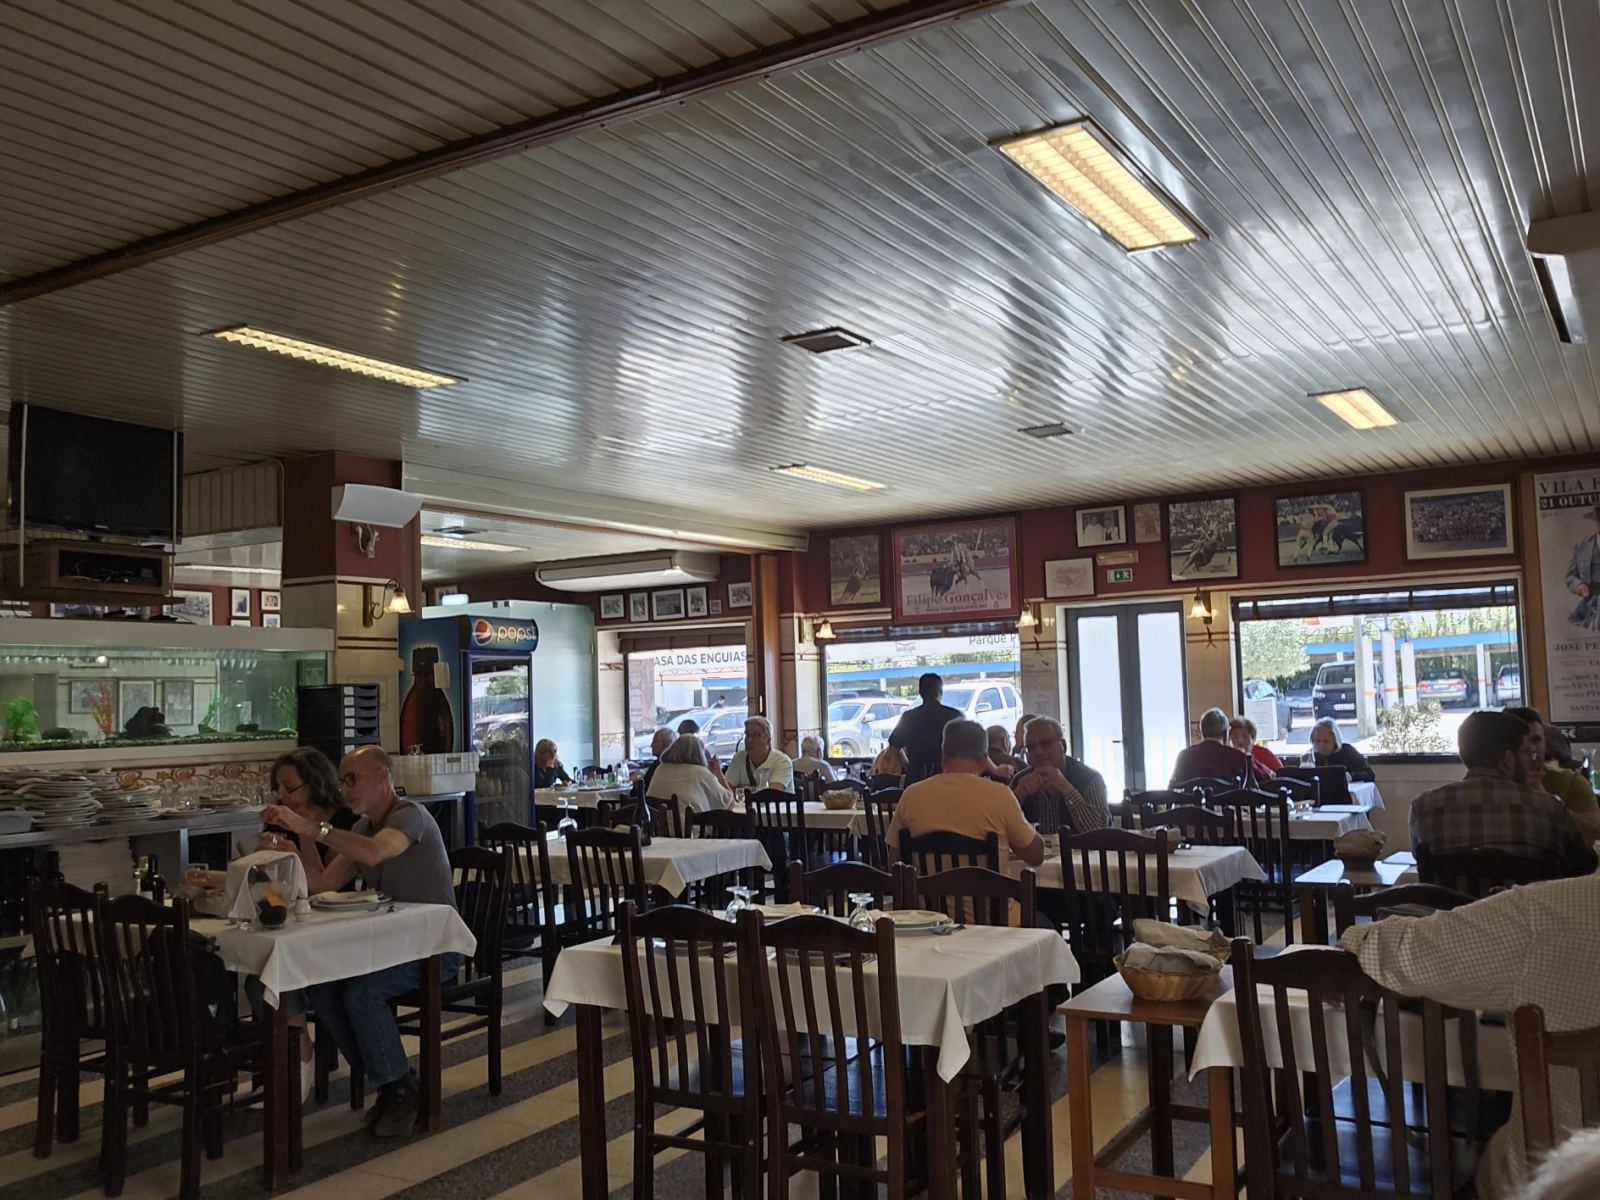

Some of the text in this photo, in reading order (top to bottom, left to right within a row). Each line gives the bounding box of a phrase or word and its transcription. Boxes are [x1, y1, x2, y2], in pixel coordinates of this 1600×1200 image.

[1539, 479, 1584, 494] VILA
[1540, 498, 1554, 509] 21
[906, 588, 1009, 607] Filipe Gonçalves
[496, 626, 537, 643] pepsi
[969, 633, 1007, 645] Parque
[677, 653, 697, 665] DAS
[700, 651, 746, 664] ENGUIAS
